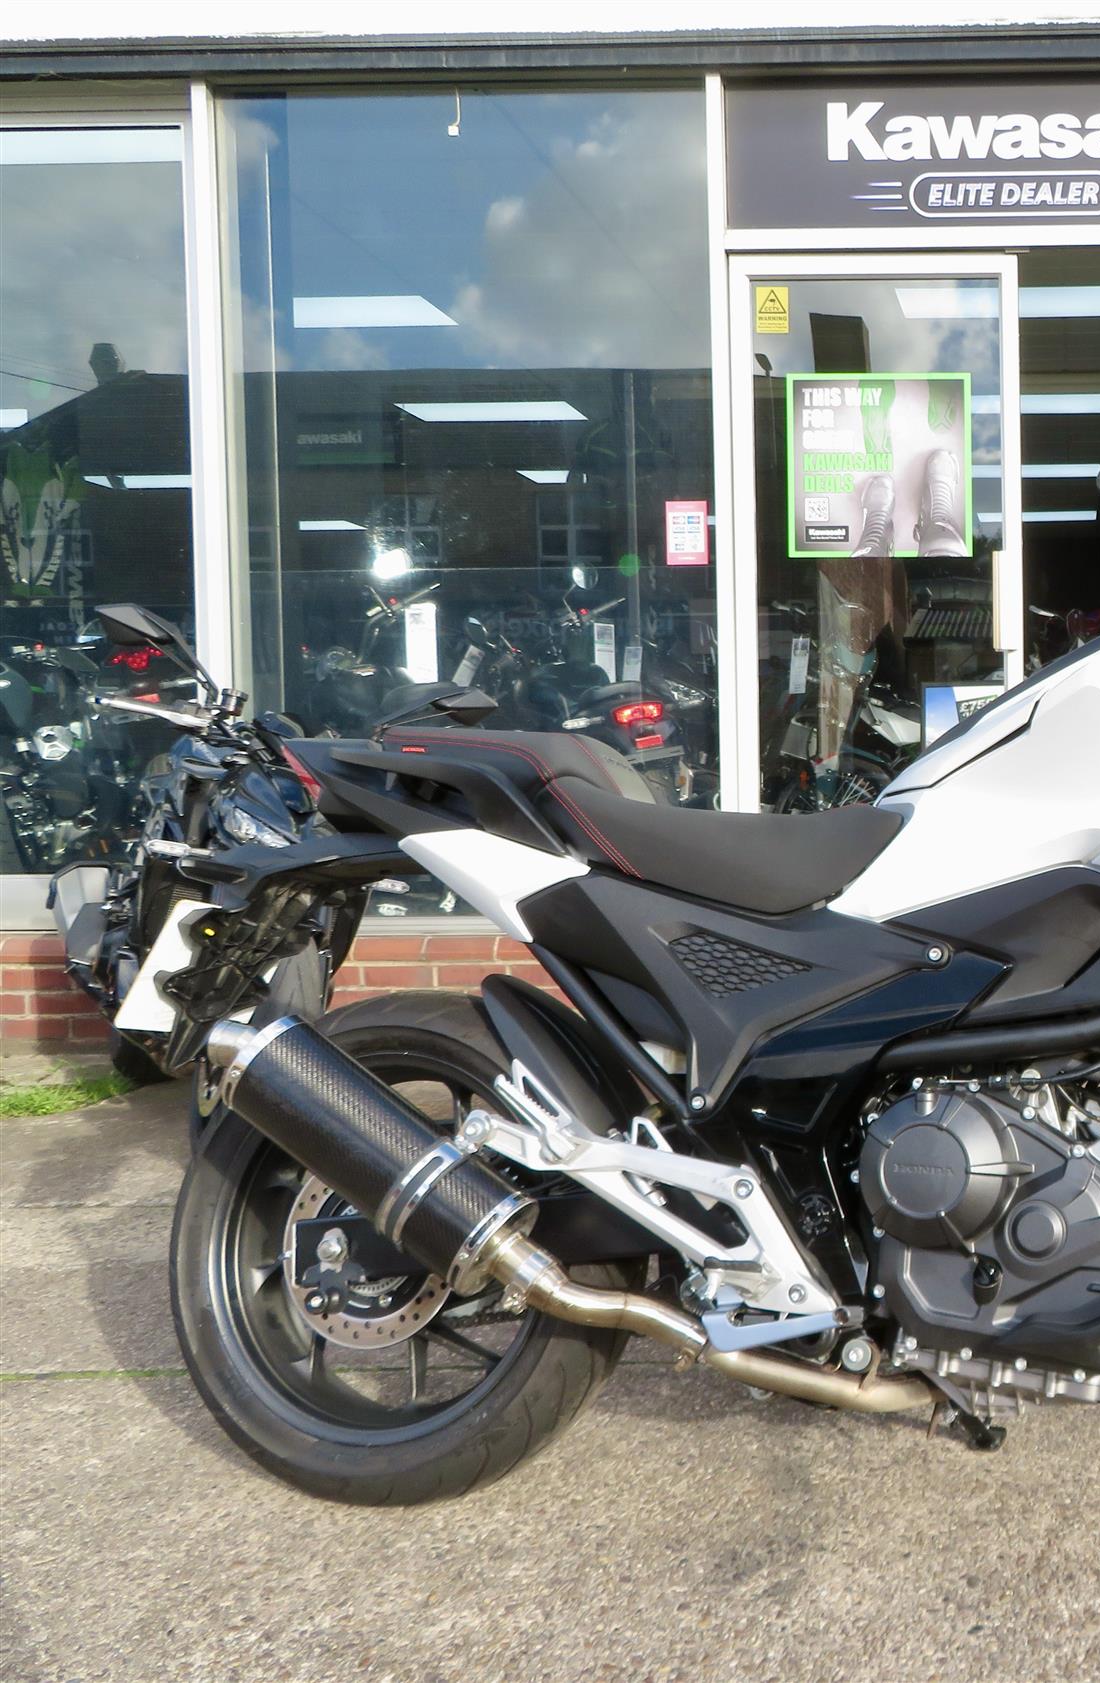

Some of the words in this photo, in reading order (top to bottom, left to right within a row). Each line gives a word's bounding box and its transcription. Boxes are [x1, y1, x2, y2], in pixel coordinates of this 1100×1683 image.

[928, 183, 994, 206] ELITE
[1000, 181, 1099, 206] DEALER
[802, 387, 842, 407] THIS
[844, 387, 882, 407] WAY
[296, 429, 362, 445] awasaki
[803, 452, 893, 472] KAWASAKI
[803, 474, 855, 493] DEALS
